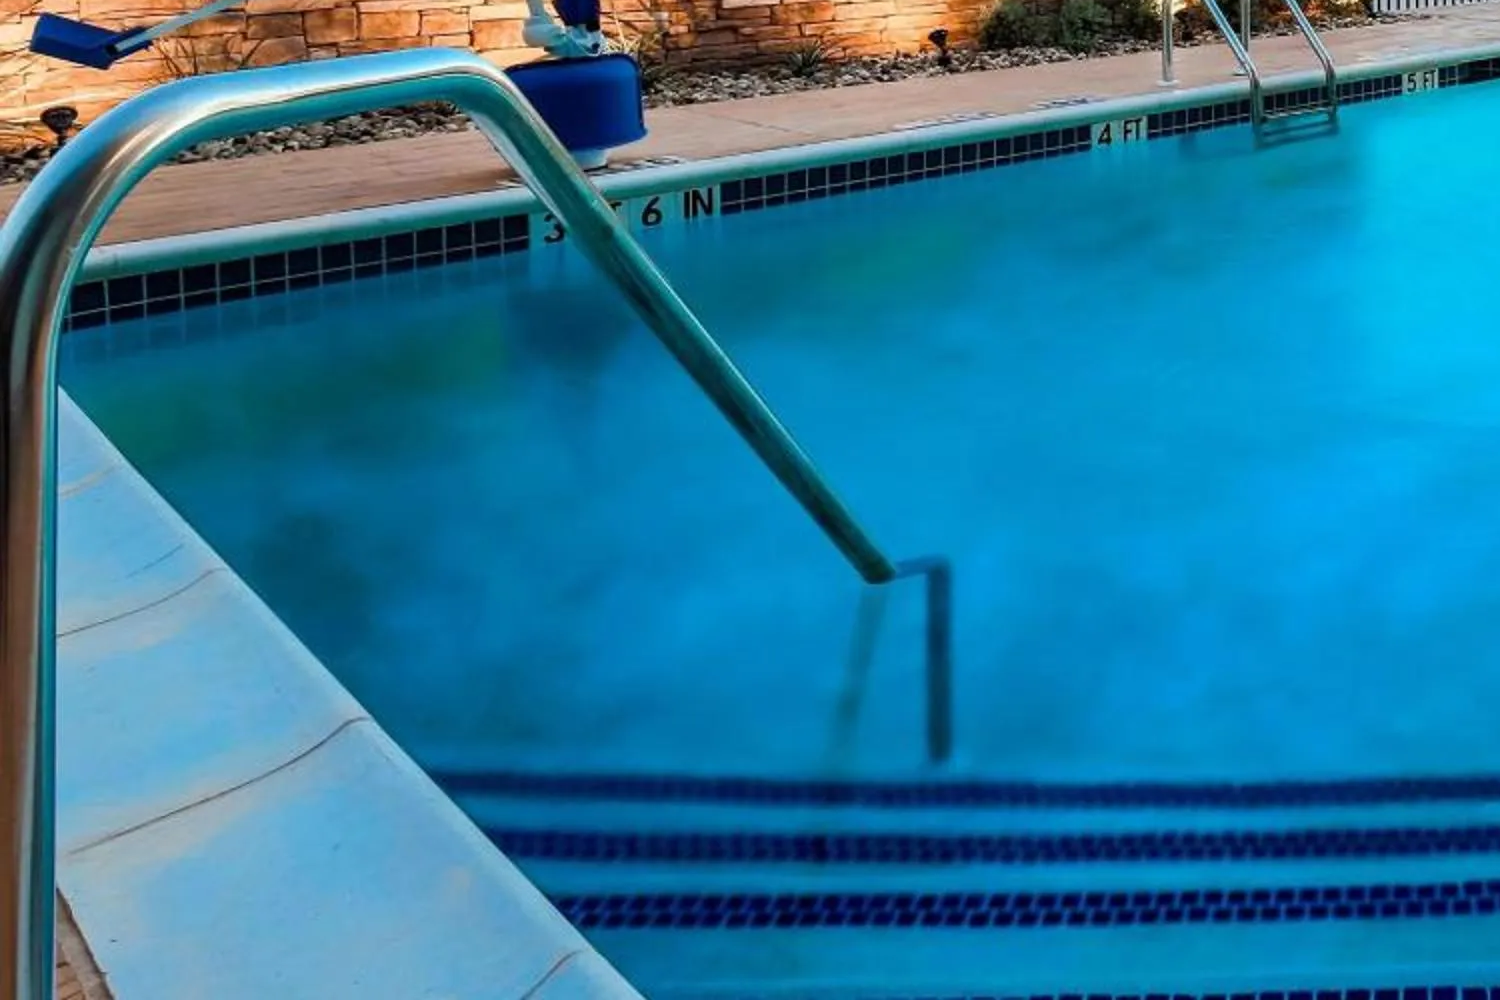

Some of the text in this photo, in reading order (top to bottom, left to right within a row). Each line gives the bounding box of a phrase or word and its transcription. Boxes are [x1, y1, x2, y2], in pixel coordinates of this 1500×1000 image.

[1407, 69, 1437, 92] 5 FT
[1097, 118, 1142, 144] 4 FT
[543, 187, 713, 243] 3 6 IN
